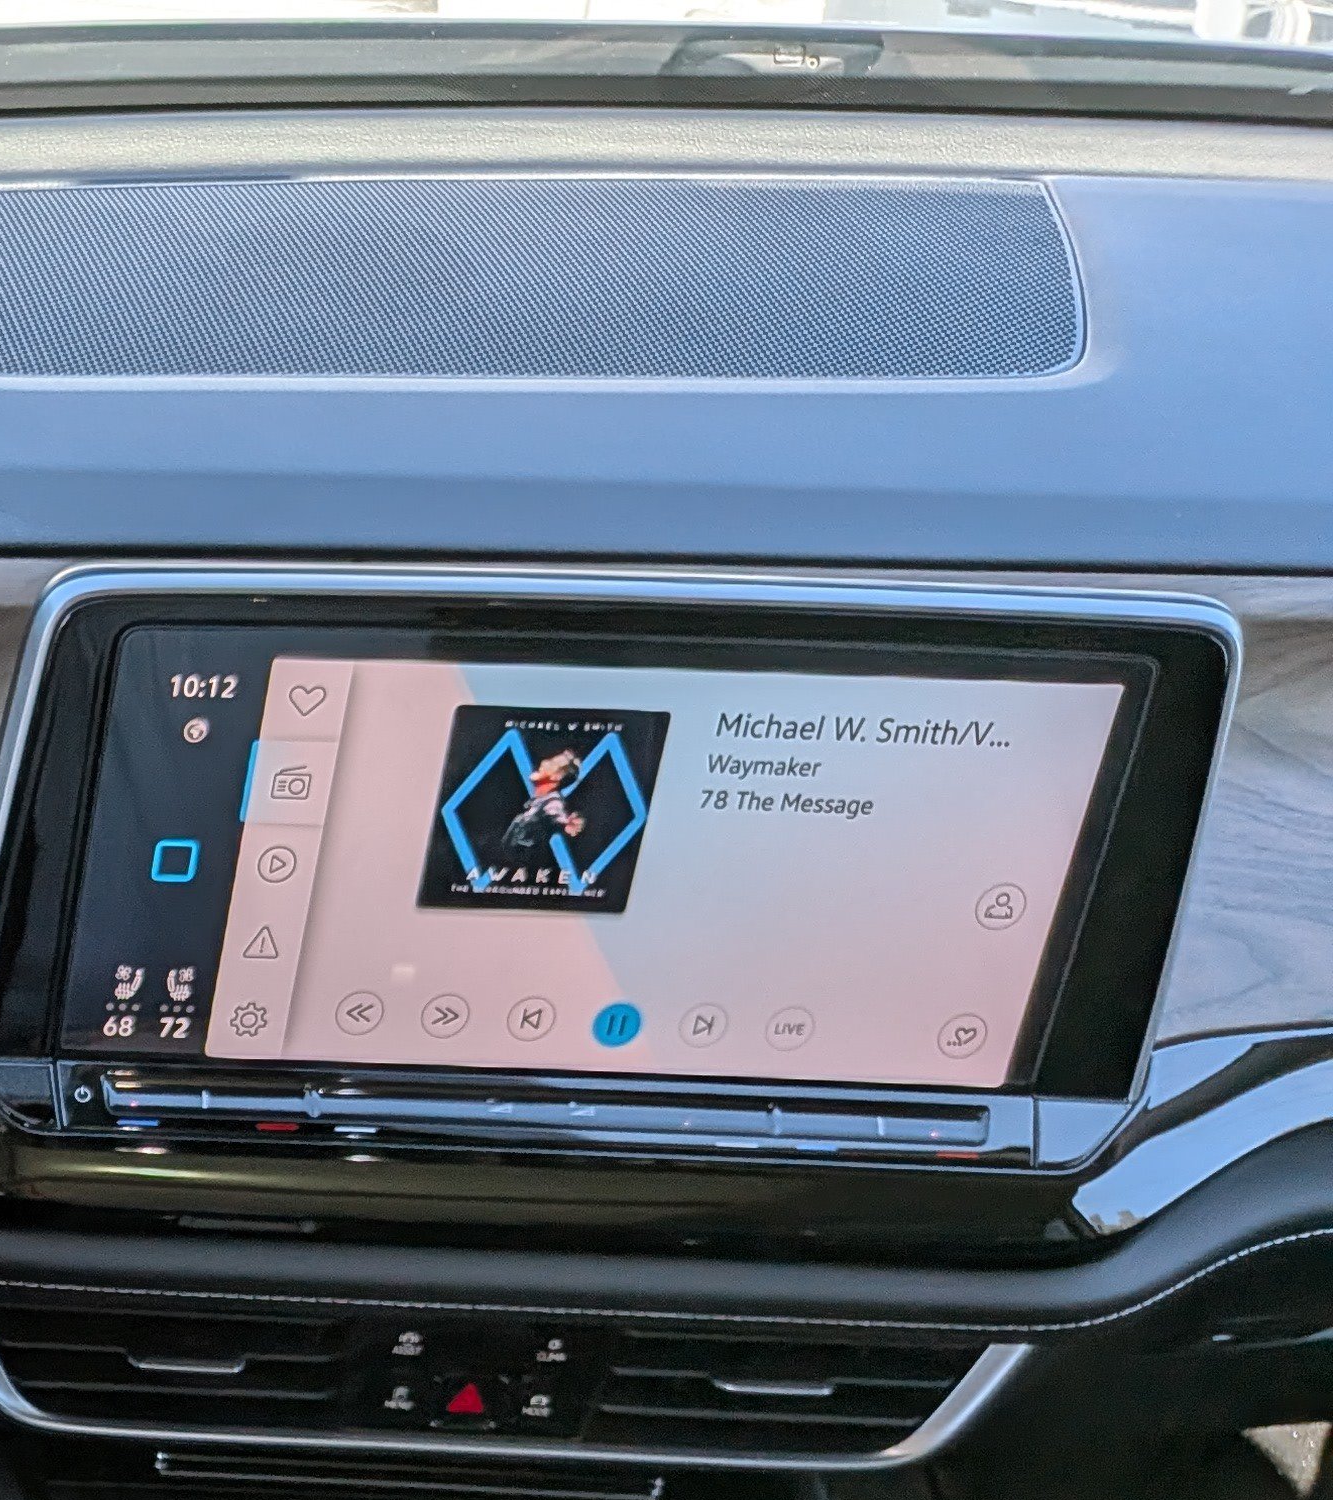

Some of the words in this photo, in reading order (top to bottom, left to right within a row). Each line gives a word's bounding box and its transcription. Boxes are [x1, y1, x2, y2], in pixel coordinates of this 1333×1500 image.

[171, 673, 238, 699] 10:12
[716, 712, 826, 743] Michael
[834, 716, 867, 743] W.
[708, 754, 821, 780] Waymaker
[700, 789, 727, 811] 78
[736, 791, 774, 812] The
[780, 793, 874, 819] Message
[466, 866, 597, 885] AWAKEN
[103, 1015, 133, 1038] 68
[160, 1016, 191, 1039] 72
[774, 1022, 805, 1038] LIVE
